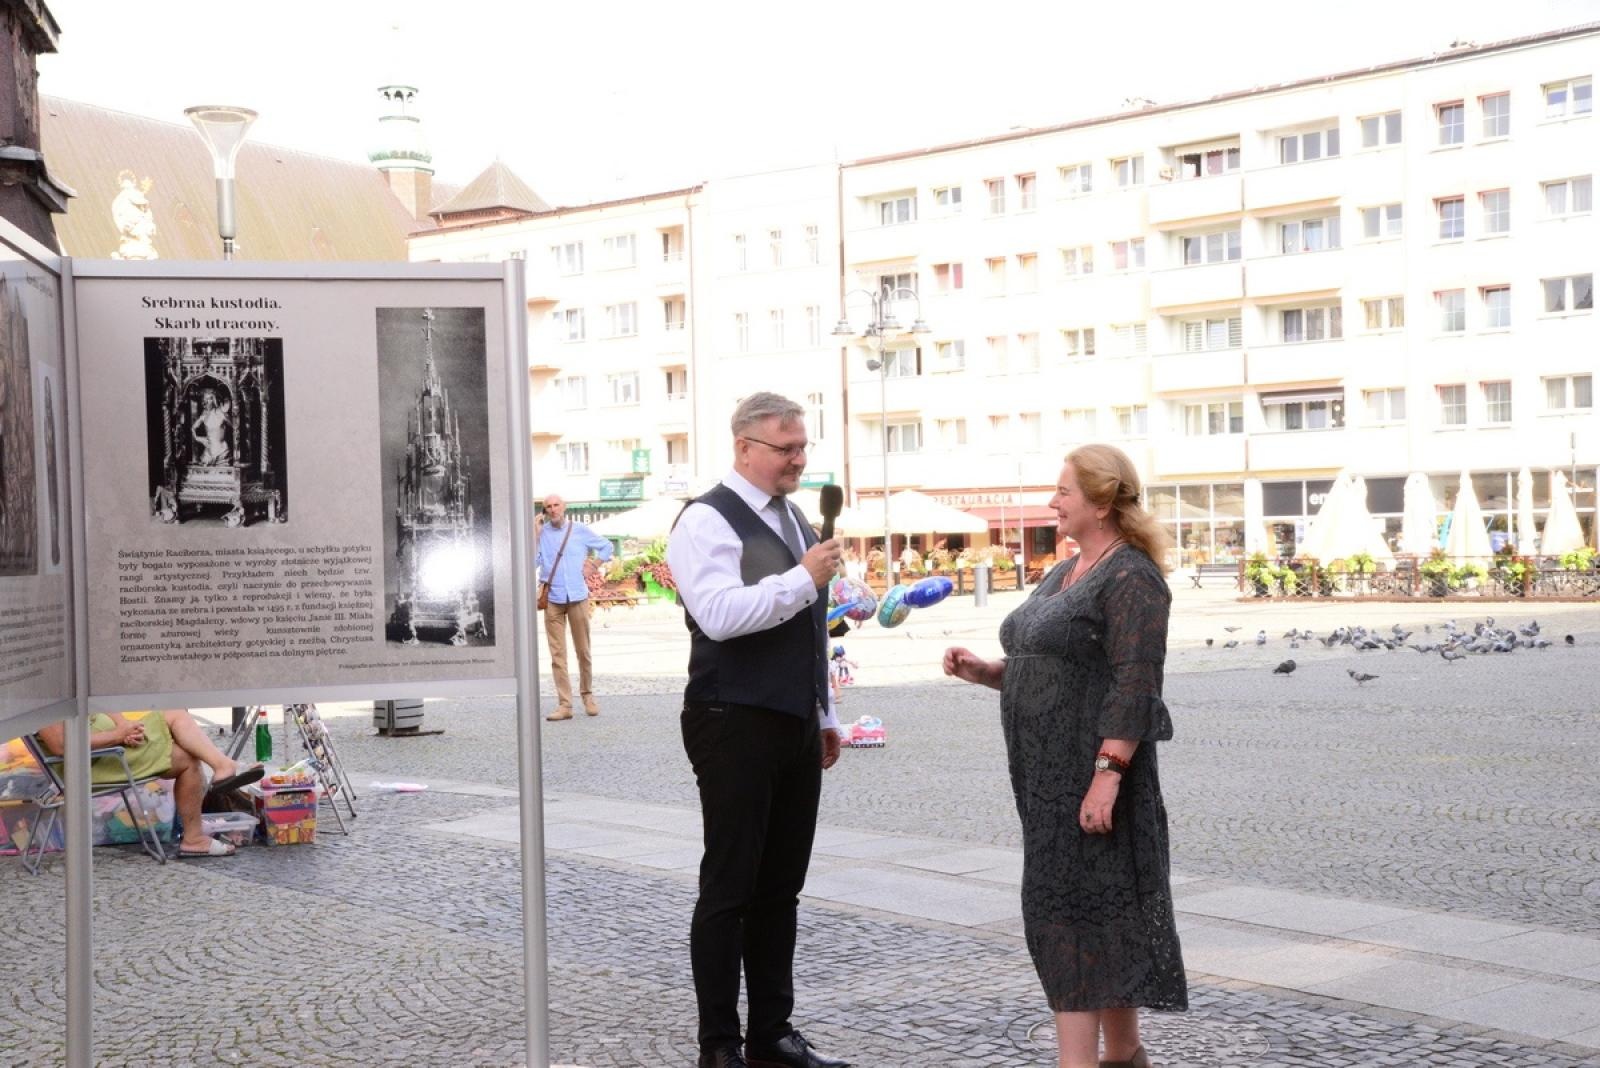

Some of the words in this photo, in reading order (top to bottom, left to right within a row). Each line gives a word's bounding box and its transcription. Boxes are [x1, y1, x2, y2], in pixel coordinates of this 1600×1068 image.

[141, 295, 206, 309] Srebrna
[210, 296, 283, 309] kustodia.
[154, 317, 201, 329] Skarb
[205, 318, 280, 332] utracony.
[215, 547, 245, 556] miasta
[306, 545, 341, 554] schyłku
[342, 544, 372, 554] gotyku
[118, 562, 138, 571] były
[142, 561, 173, 571] bogato
[176, 560, 231, 570] wyposażone
[245, 558, 277, 567] wyroby
[323, 556, 372, 565] wyjątkowej
[119, 573, 144, 583] rangi
[222, 570, 274, 579] Przykładem
[284, 569, 308, 577] niech
[317, 568, 345, 577] będzie
[119, 584, 168, 593] raciborska
[217, 582, 239, 592] czyli
[243, 581, 282, 590] naczynie
[286, 580, 297, 588] do
[301, 579, 373, 589] przechowywania
[154, 595, 186, 605] Znamy
[190, 594, 200, 604] ją
[204, 593, 228, 603] tylko
[242, 591, 292, 602] reprodukcji
[354, 589, 373, 598] była
[119, 608, 167, 618] wykonana
[180, 605, 209, 615] srebra
[216, 604, 255, 614] powstała
[301, 601, 337, 611] fundacji
[338, 600, 373, 610] księżnej
[119, 619, 174, 628] raciborskiej
[230, 615, 260, 625] wdowy
[262, 616, 274, 624] po
[275, 614, 307, 624] księciu
[308, 613, 333, 622] Janie
[349, 611, 374, 620] Miała
[119, 630, 147, 640] formę
[160, 629, 202, 639] ażurowej
[214, 627, 240, 637] wieży
[266, 625, 321, 635] kunsztownie
[333, 623, 374, 633] zdobionej
[185, 639, 242, 650] architektury
[245, 638, 286, 648] gotyckiej
[330, 634, 374, 644] Chrystusa
[269, 650, 281, 658] na
[282, 647, 314, 659] dolnym
